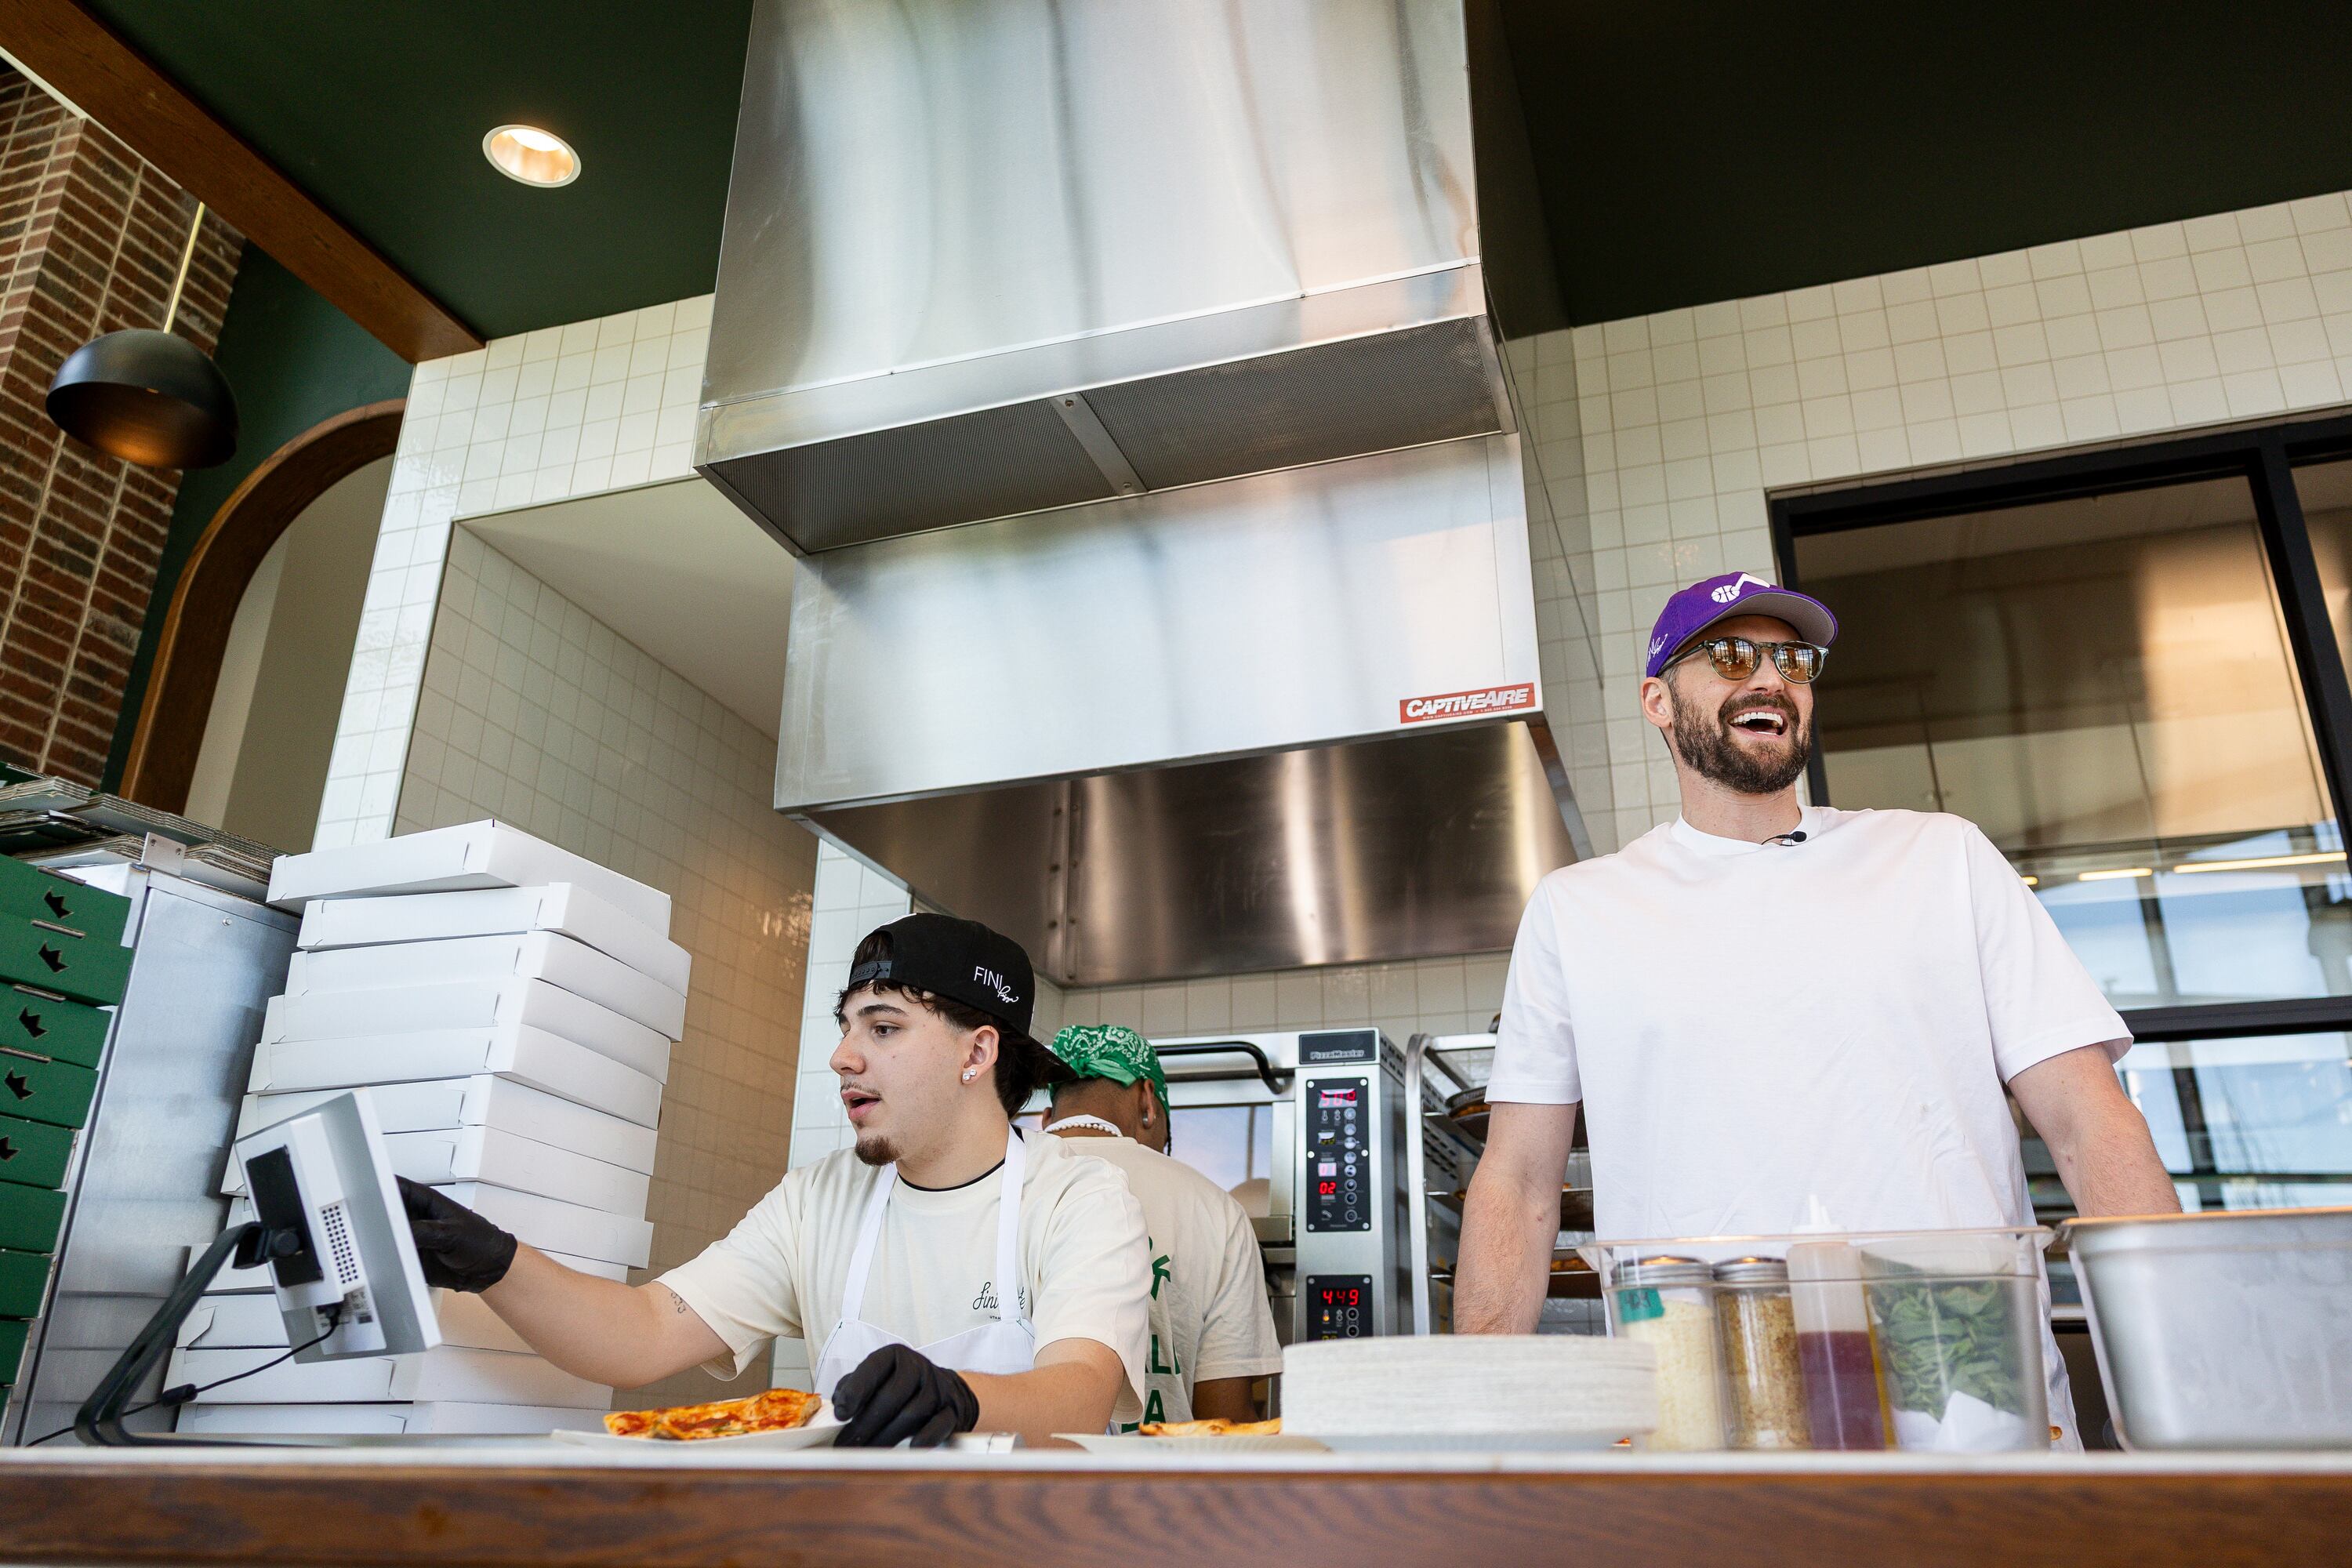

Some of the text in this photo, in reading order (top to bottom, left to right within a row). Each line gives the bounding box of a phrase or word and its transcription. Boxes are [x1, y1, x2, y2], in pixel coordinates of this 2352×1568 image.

[1406, 688, 1530, 717] CAPTIVEAIRE
[974, 965, 1003, 990] FINI
[1319, 1181, 1337, 1195] 02
[1323, 1289, 1359, 1305] 449
